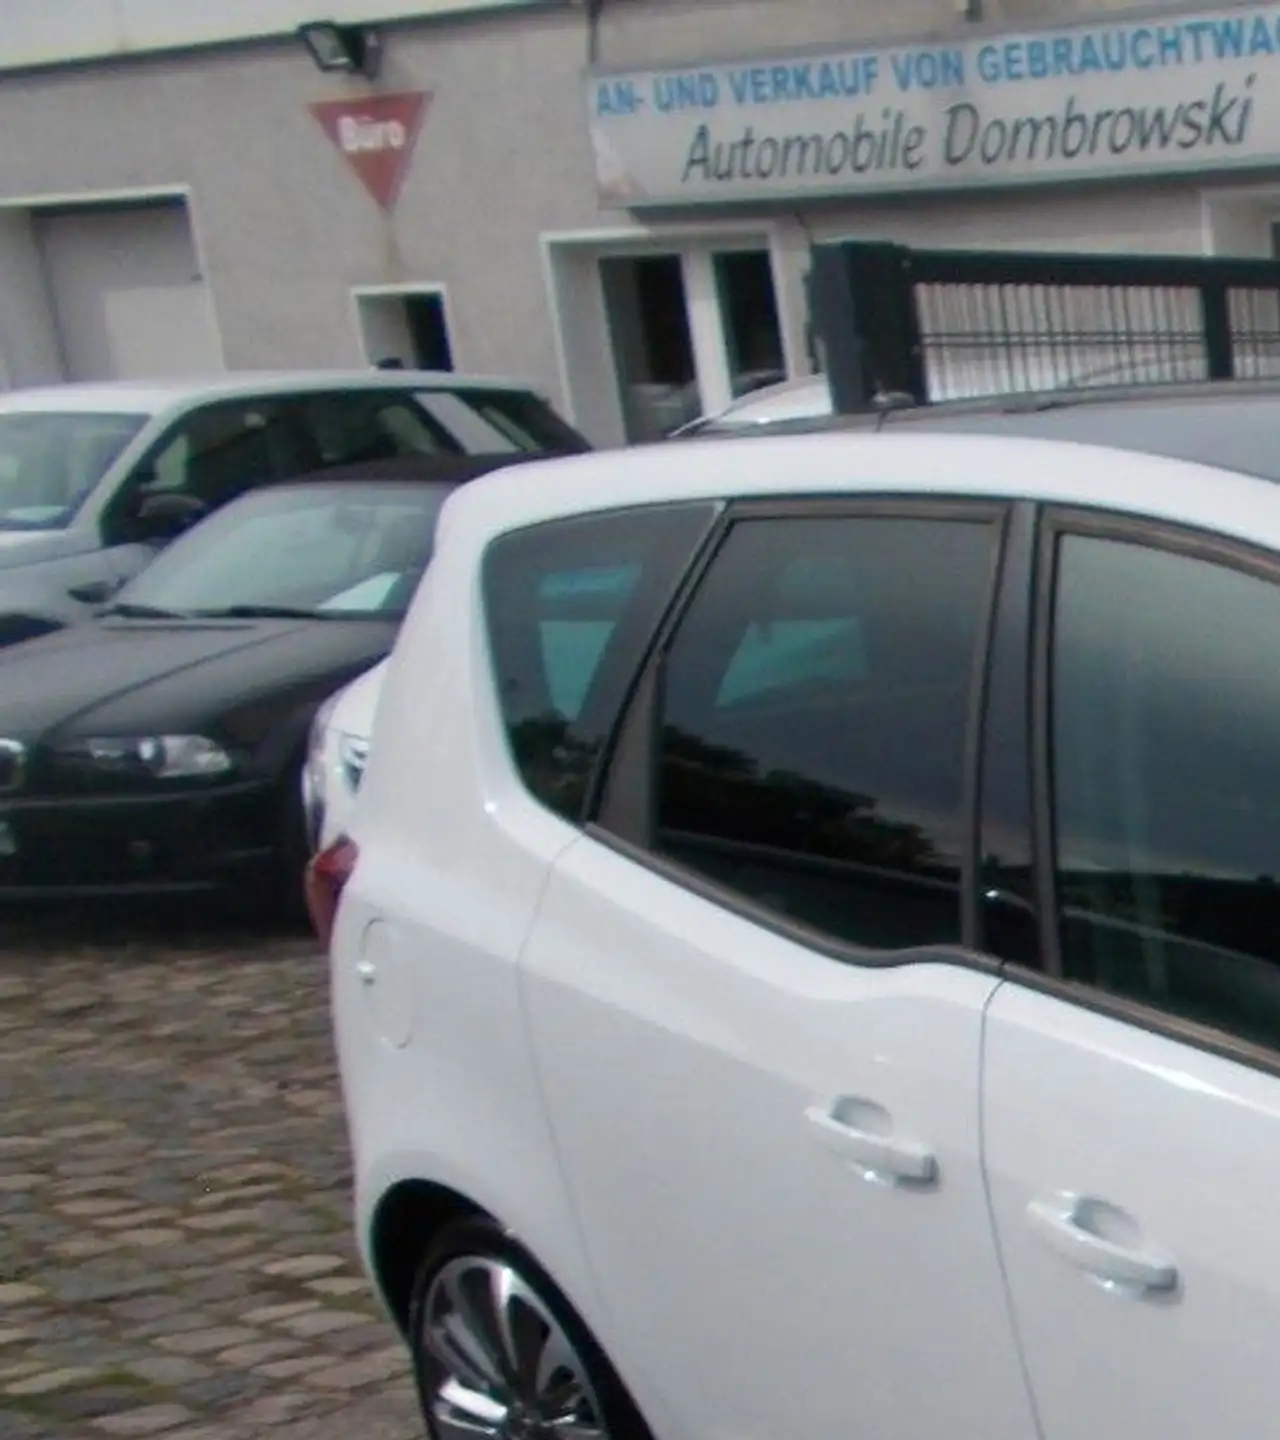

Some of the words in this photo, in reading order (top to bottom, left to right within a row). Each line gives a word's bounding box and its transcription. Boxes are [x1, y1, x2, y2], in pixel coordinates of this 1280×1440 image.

[595, 79, 644, 117] AN-
[652, 72, 720, 113] UND
[728, 56, 879, 107] VERKAUF
[890, 50, 965, 92] VON
[681, 107, 927, 184] Automobile
[942, 72, 1257, 166] Dombrowski
